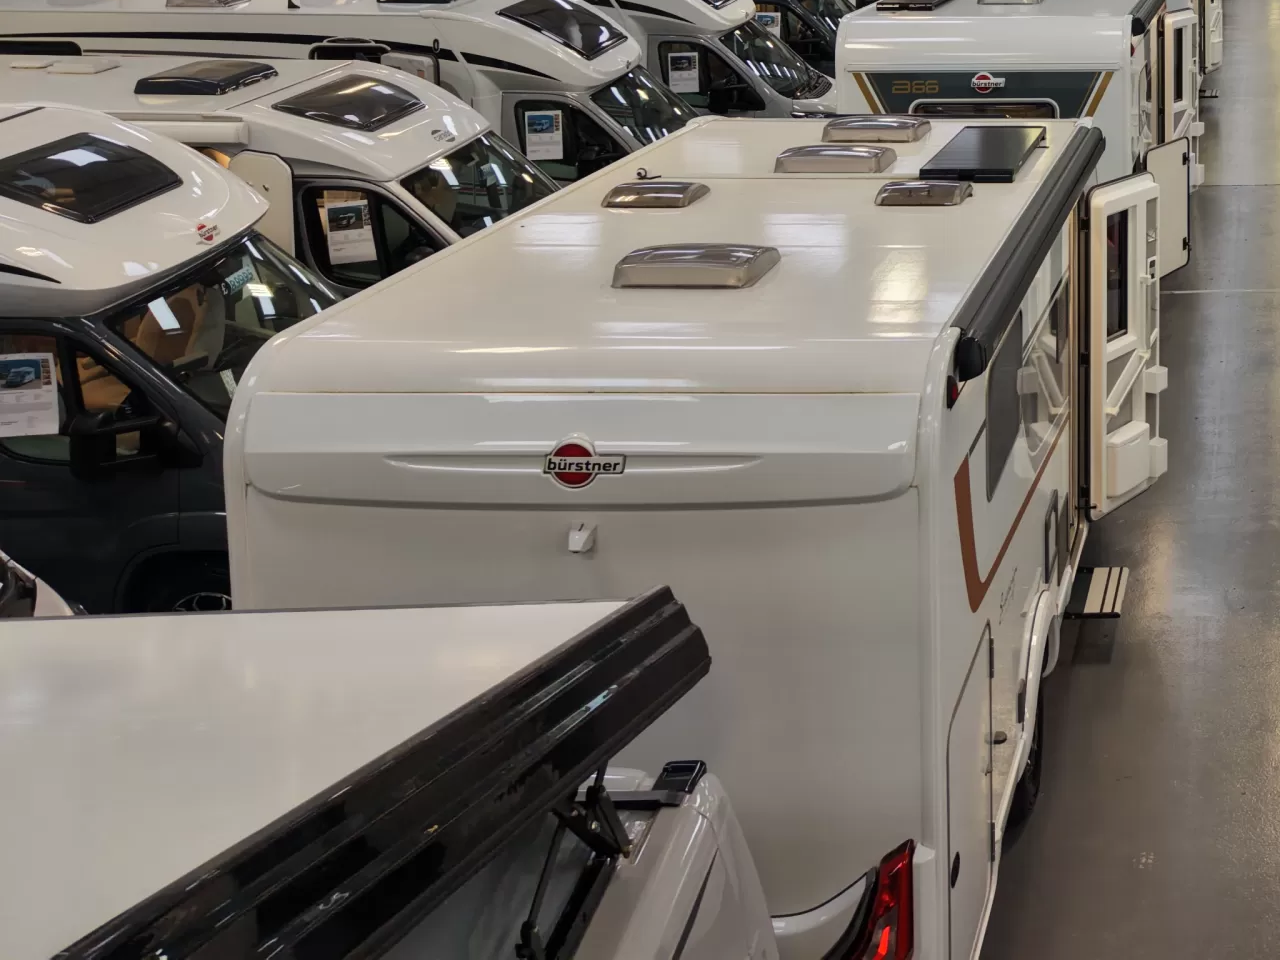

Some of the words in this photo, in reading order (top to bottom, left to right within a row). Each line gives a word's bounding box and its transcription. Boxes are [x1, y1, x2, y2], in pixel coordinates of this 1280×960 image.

[972, 80, 1002, 88] bürstner
[198, 224, 218, 238] bürstner
[547, 458, 621, 473] bürstner
